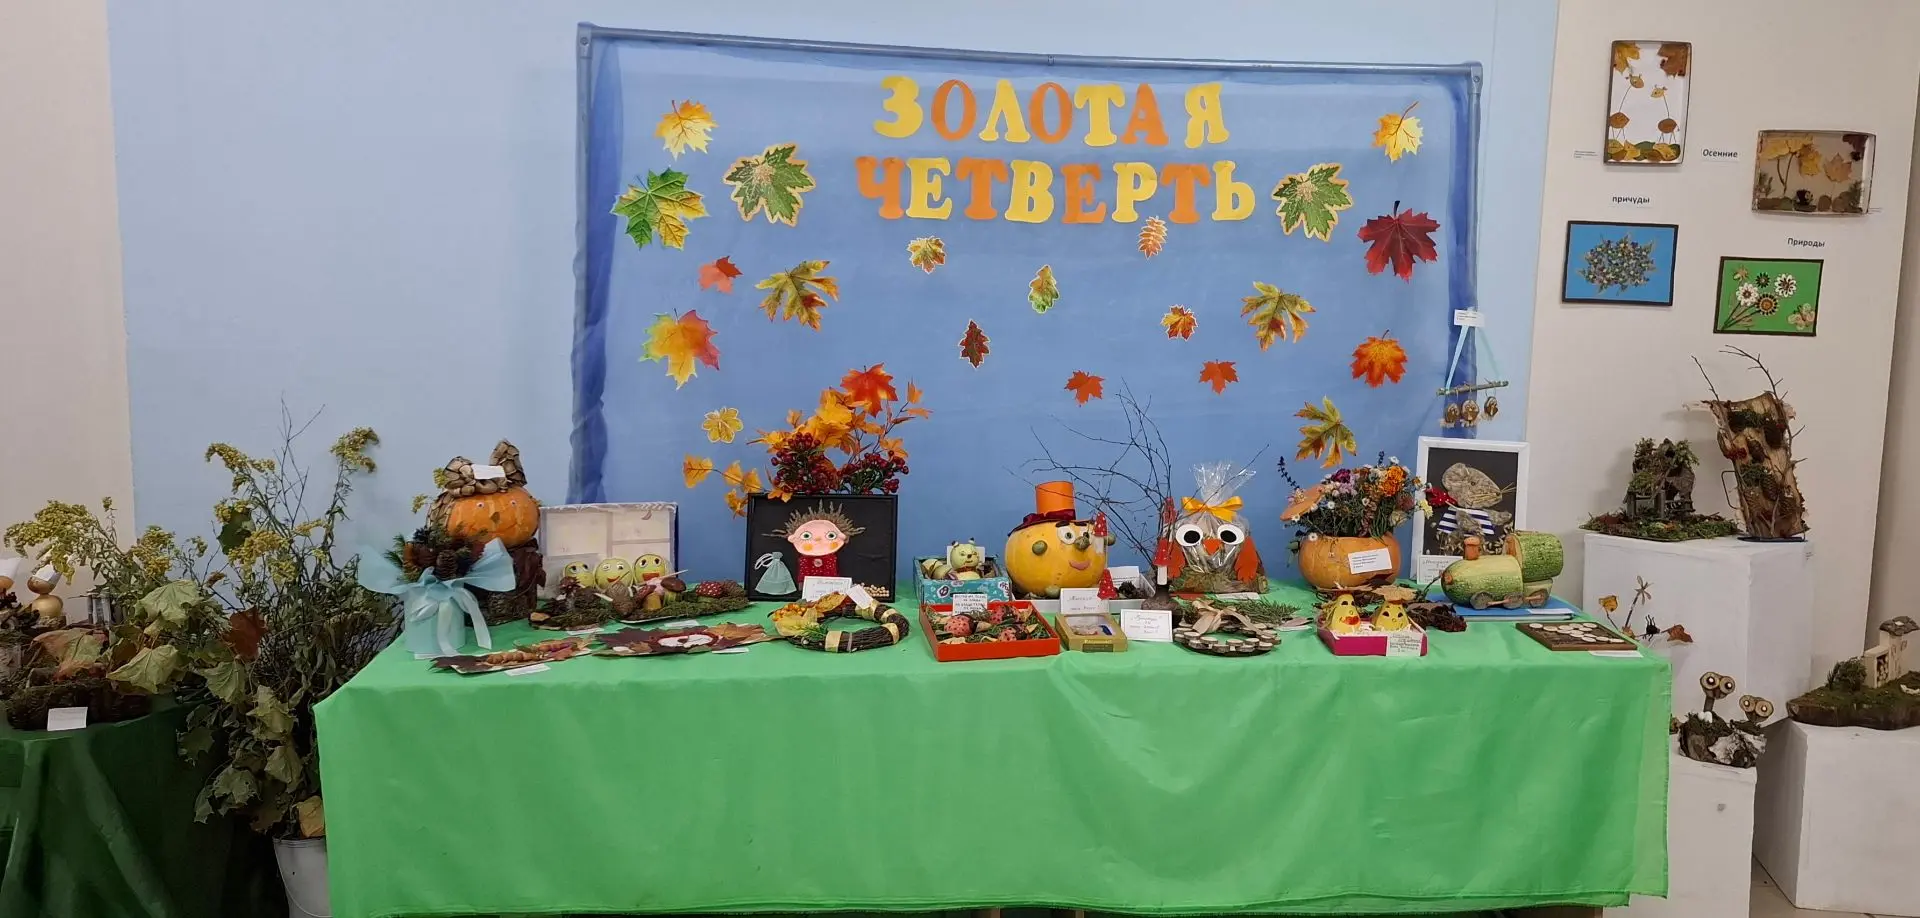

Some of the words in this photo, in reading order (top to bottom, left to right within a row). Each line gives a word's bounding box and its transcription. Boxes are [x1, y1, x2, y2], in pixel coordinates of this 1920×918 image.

[873, 76, 1230, 148] ЗОЛОТАЯ
[1702, 148, 1738, 158] Осенние
[855, 156, 1256, 224] ЧЕТВЕРТЬ
[1612, 196, 1650, 205] причуды
[1787, 237, 1826, 248] Природы
